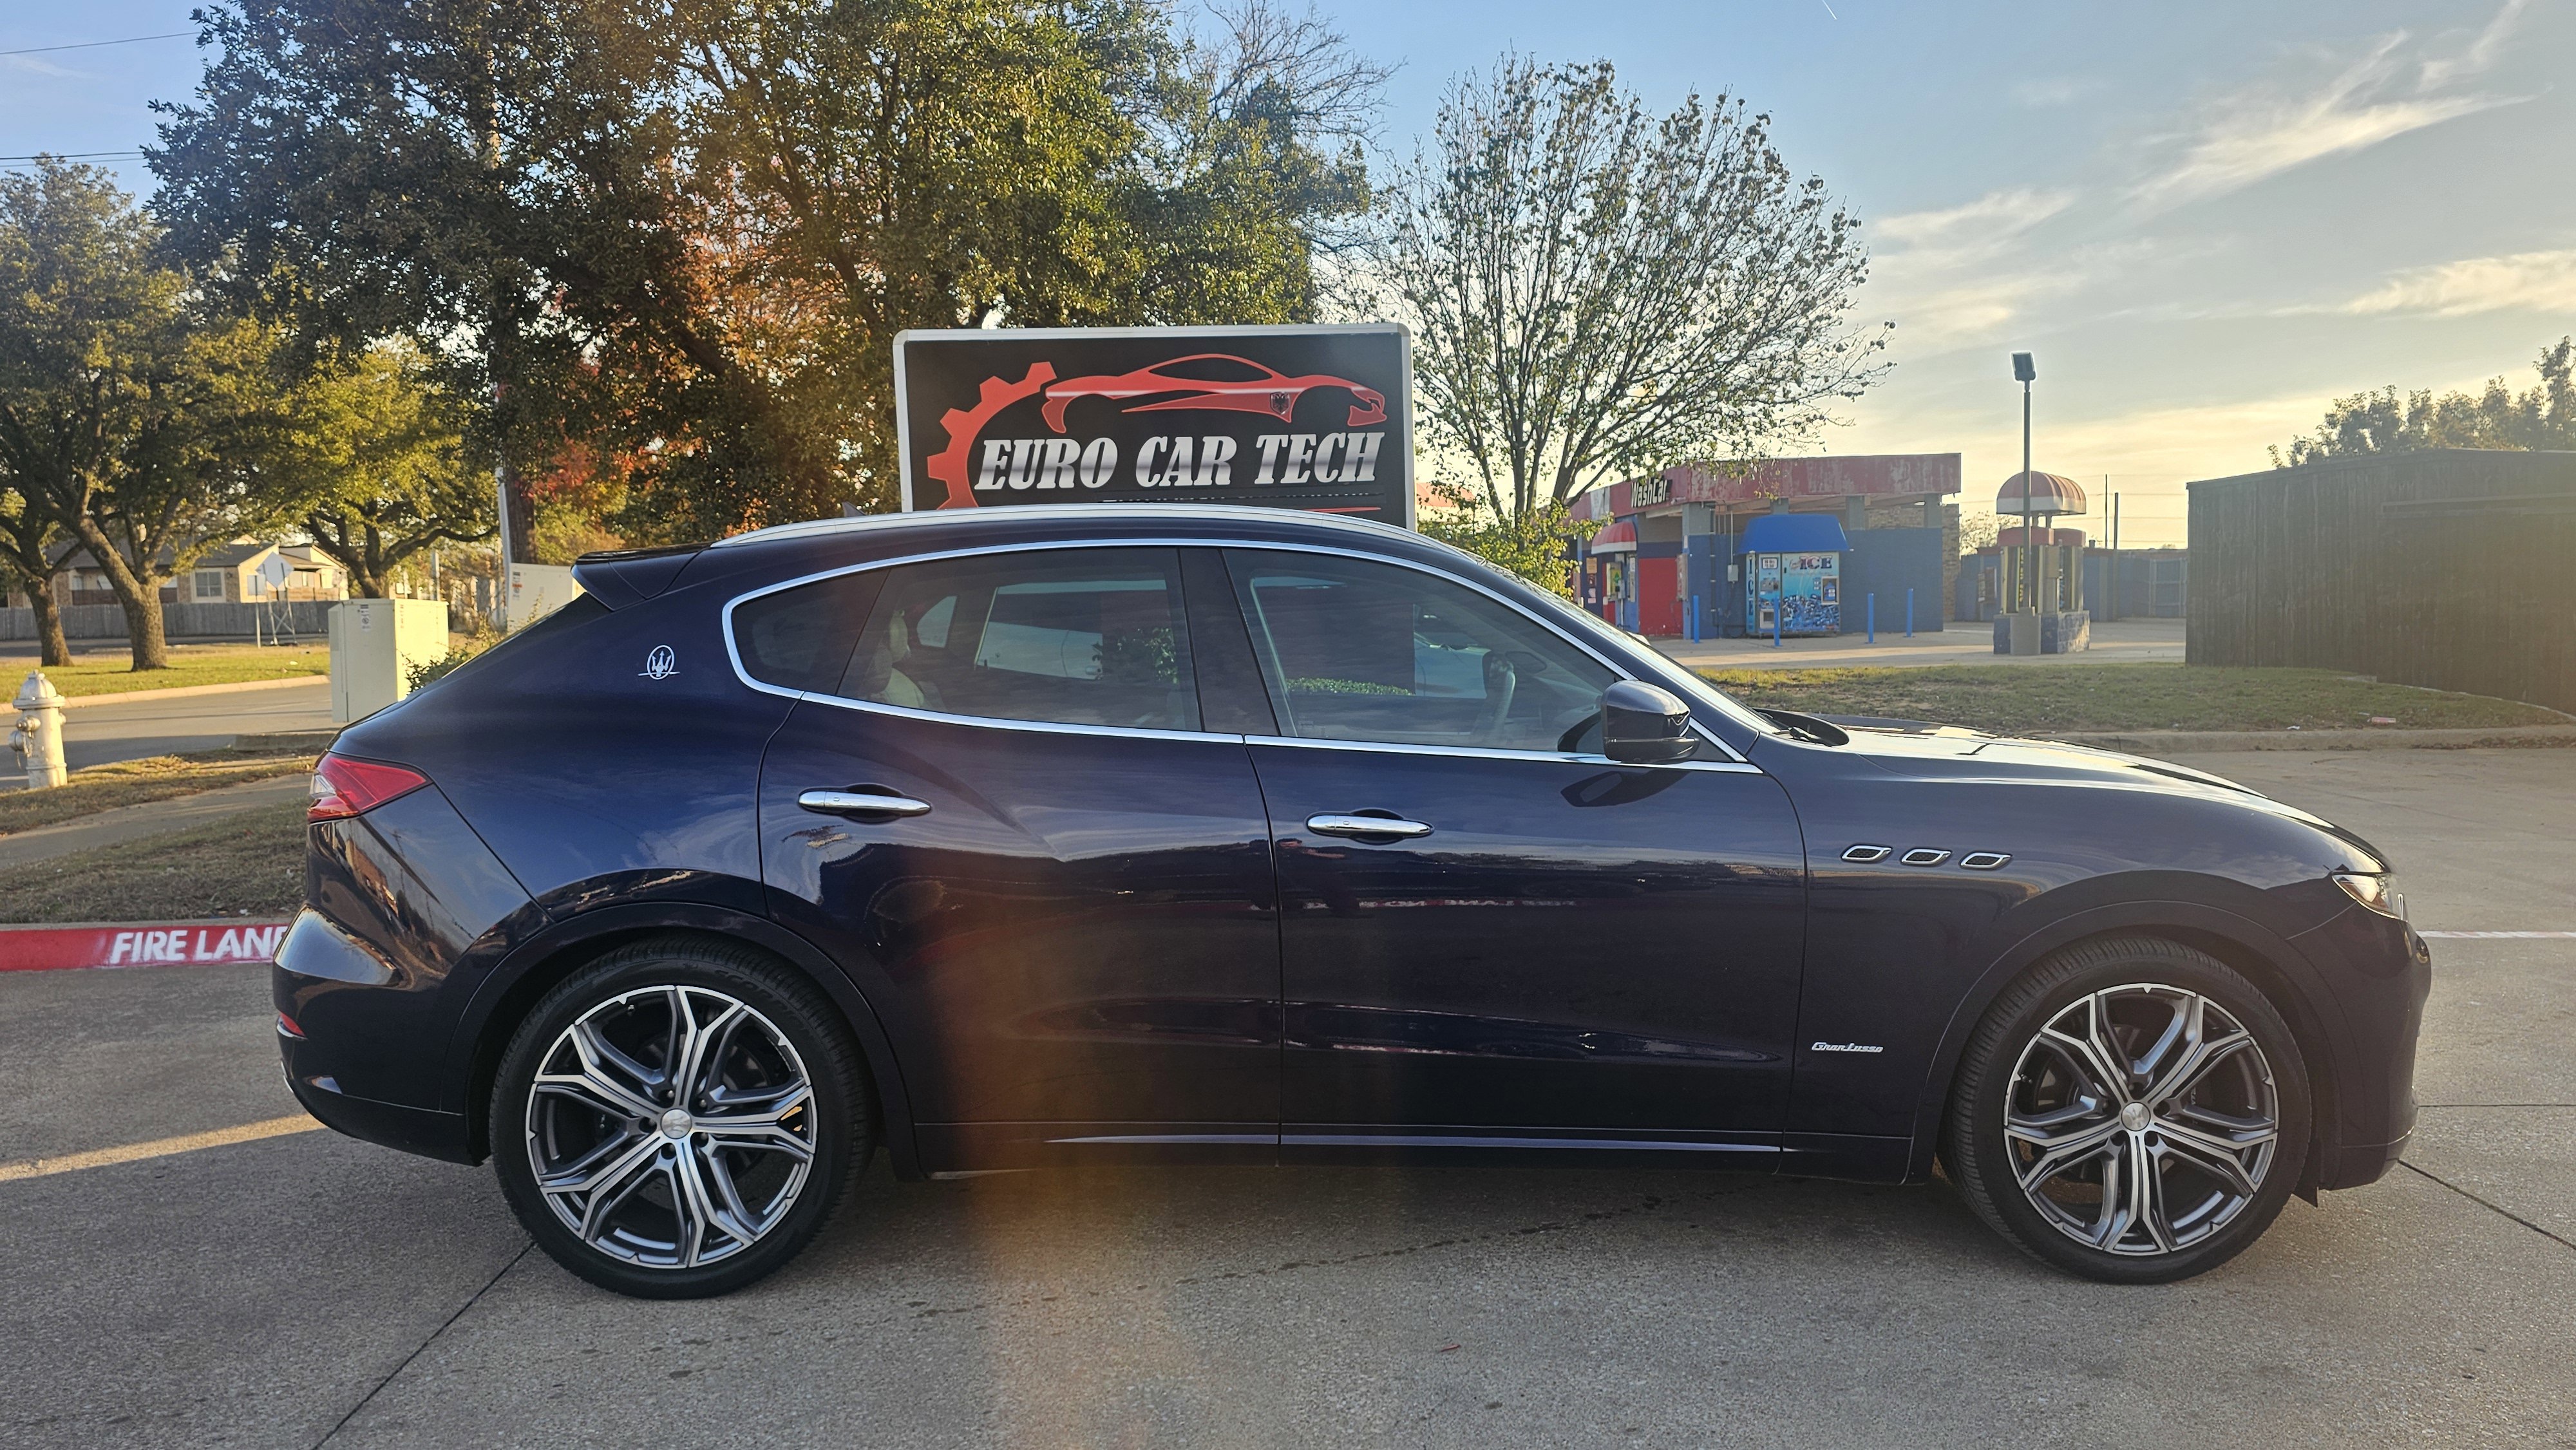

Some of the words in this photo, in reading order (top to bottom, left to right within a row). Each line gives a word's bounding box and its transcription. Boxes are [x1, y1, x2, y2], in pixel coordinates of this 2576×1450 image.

[974, 436, 1119, 491] EURO
[1135, 435, 1236, 488] CAR
[1255, 431, 1385, 485] TECH
[1799, 555, 1833, 570] ICE
[109, 930, 189, 965] FIRE
[714, 968, 813, 1039] SCORPION
